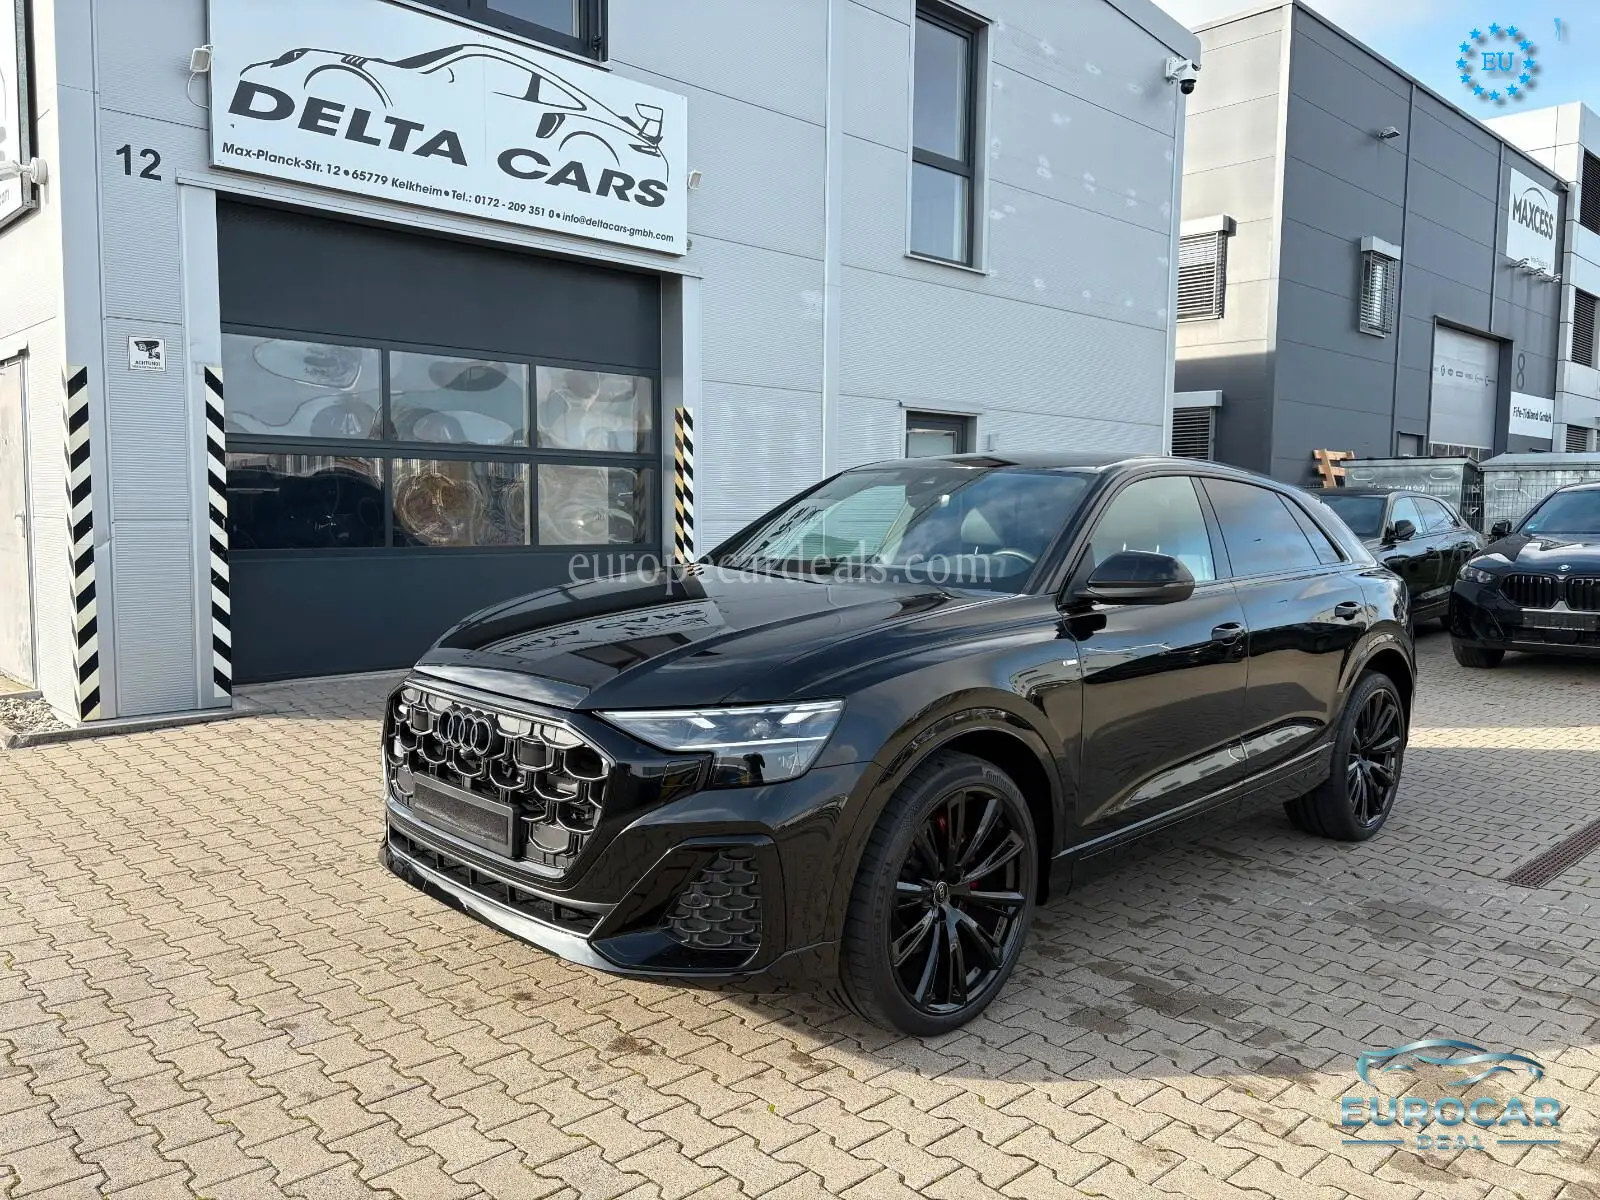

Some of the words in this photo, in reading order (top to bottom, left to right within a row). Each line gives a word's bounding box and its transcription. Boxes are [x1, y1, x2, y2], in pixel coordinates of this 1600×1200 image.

[115, 144, 162, 182] 12
[228, 80, 469, 167] DELTA
[497, 147, 667, 208] CARS
[222, 142, 323, 173] Max-Planck-Str.
[327, 163, 342, 176] 12
[351, 169, 389, 186] 65779
[391, 177, 443, 197] Kelkheim
[451, 189, 472, 203] Tel.:
[474, 194, 500, 208] 0172
[507, 201, 526, 213] 209
[528, 205, 545, 217] 351
[548, 209, 554, 219] 0
[562, 211, 674, 243] info@deltacars-gmbh.com
[1512, 193, 1554, 240] MAXCESS
[1516, 353, 1525, 390] 8
